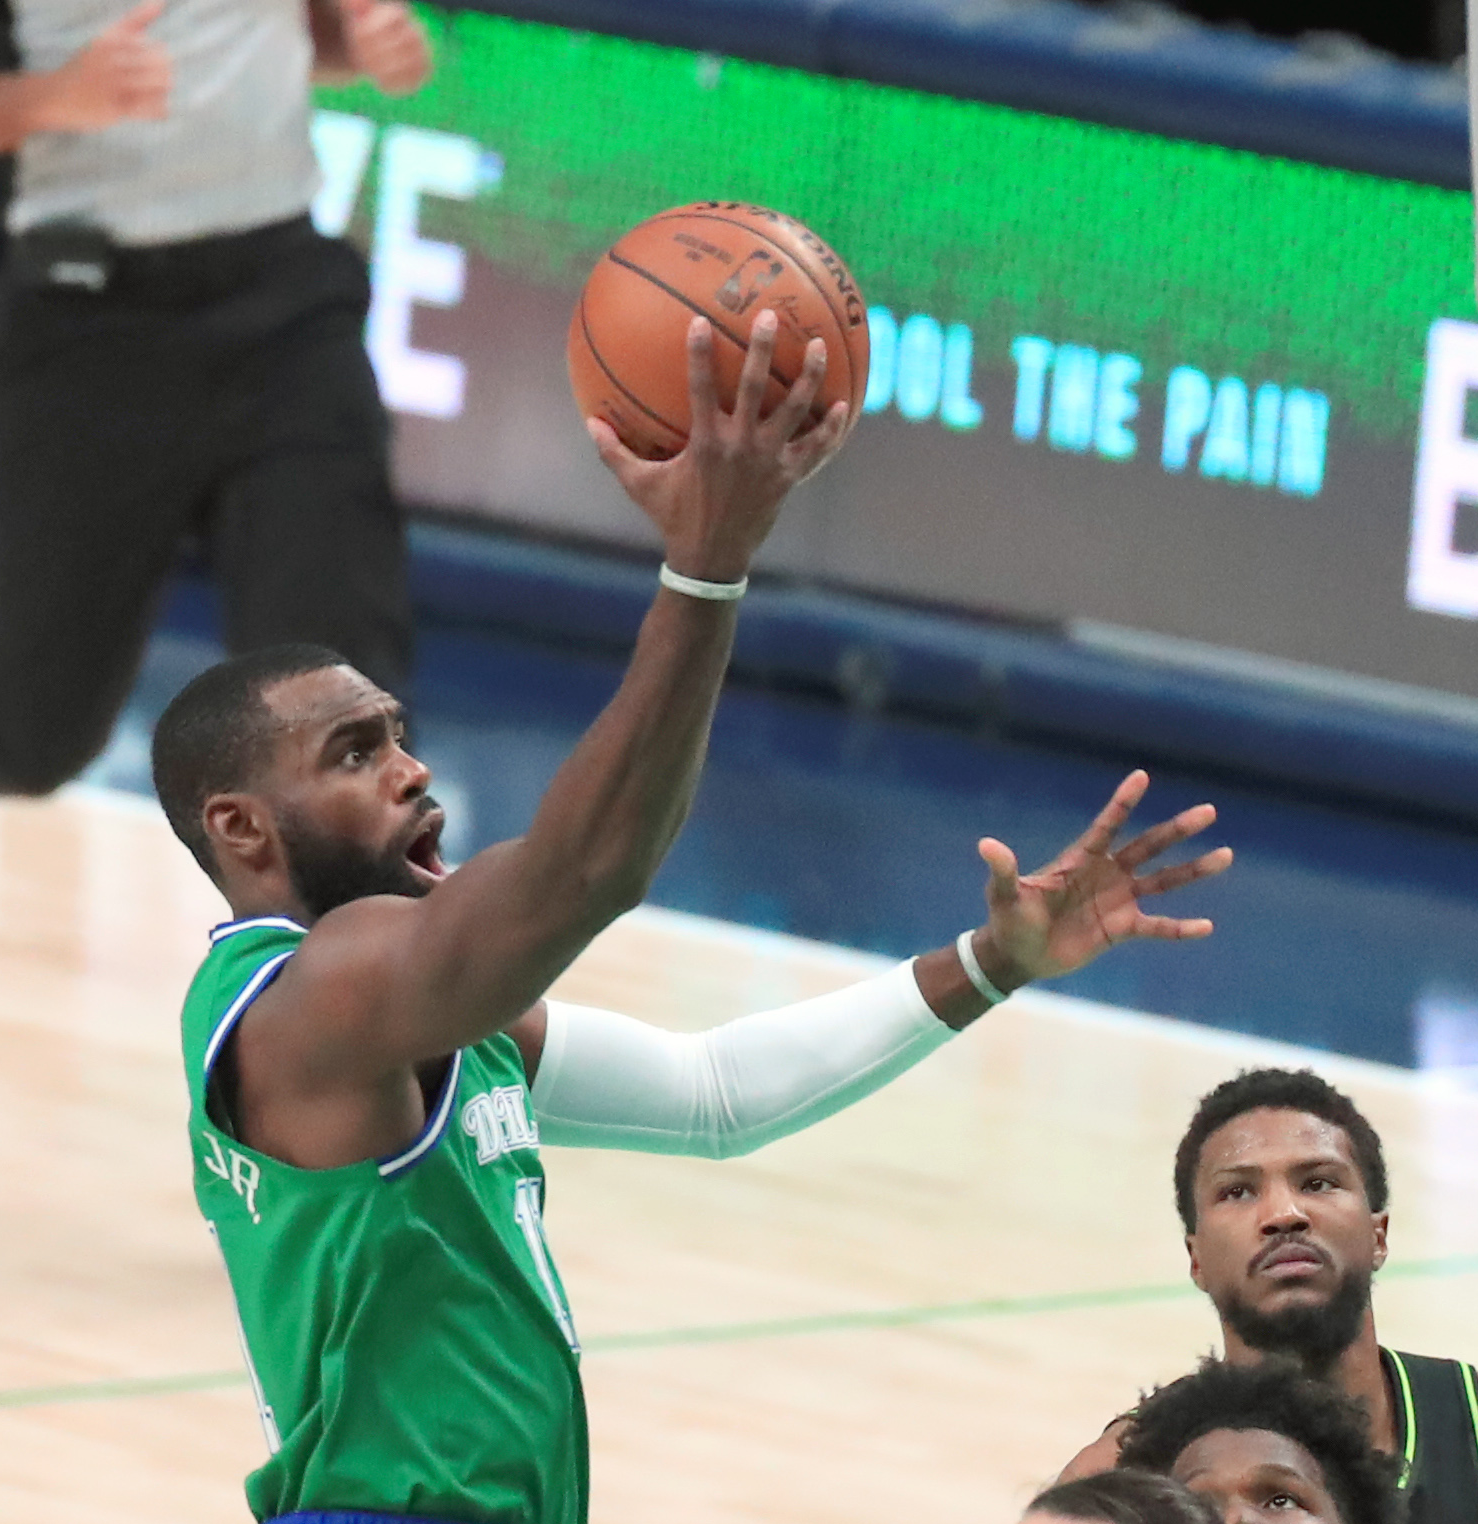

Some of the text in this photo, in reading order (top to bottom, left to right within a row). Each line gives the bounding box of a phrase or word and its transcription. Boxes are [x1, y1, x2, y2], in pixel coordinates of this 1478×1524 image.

[862, 304, 1331, 500] OOL THE PAIN
[202, 1130, 262, 1225] JR.
